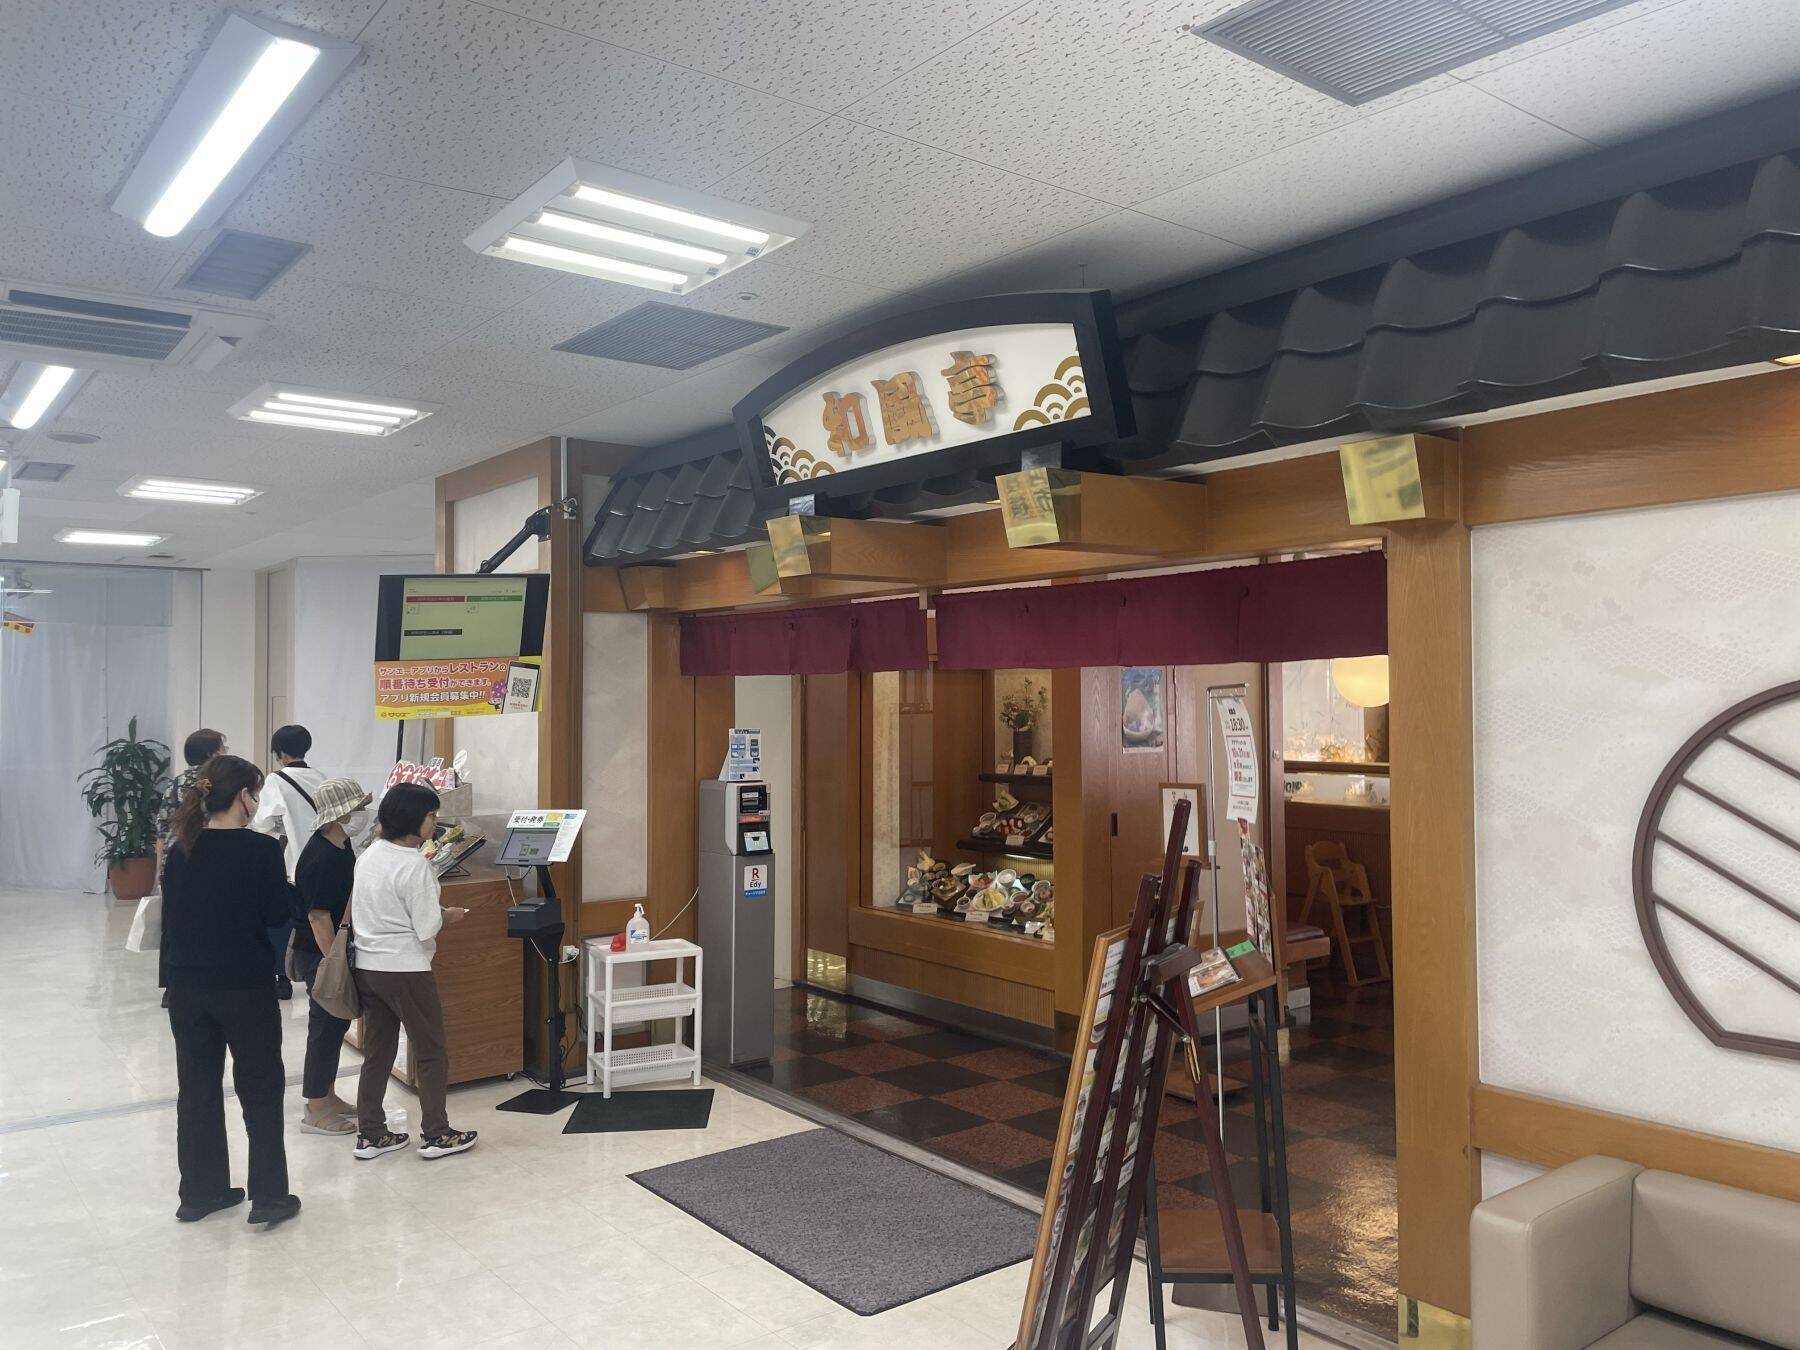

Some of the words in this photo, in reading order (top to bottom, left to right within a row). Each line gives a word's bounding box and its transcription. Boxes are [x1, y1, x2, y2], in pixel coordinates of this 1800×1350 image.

[379, 662, 507, 677] サンエーアプリからレストランの
[379, 677, 492, 690] 順番待ち受付ができます。
[752, 867, 760, 880] R
